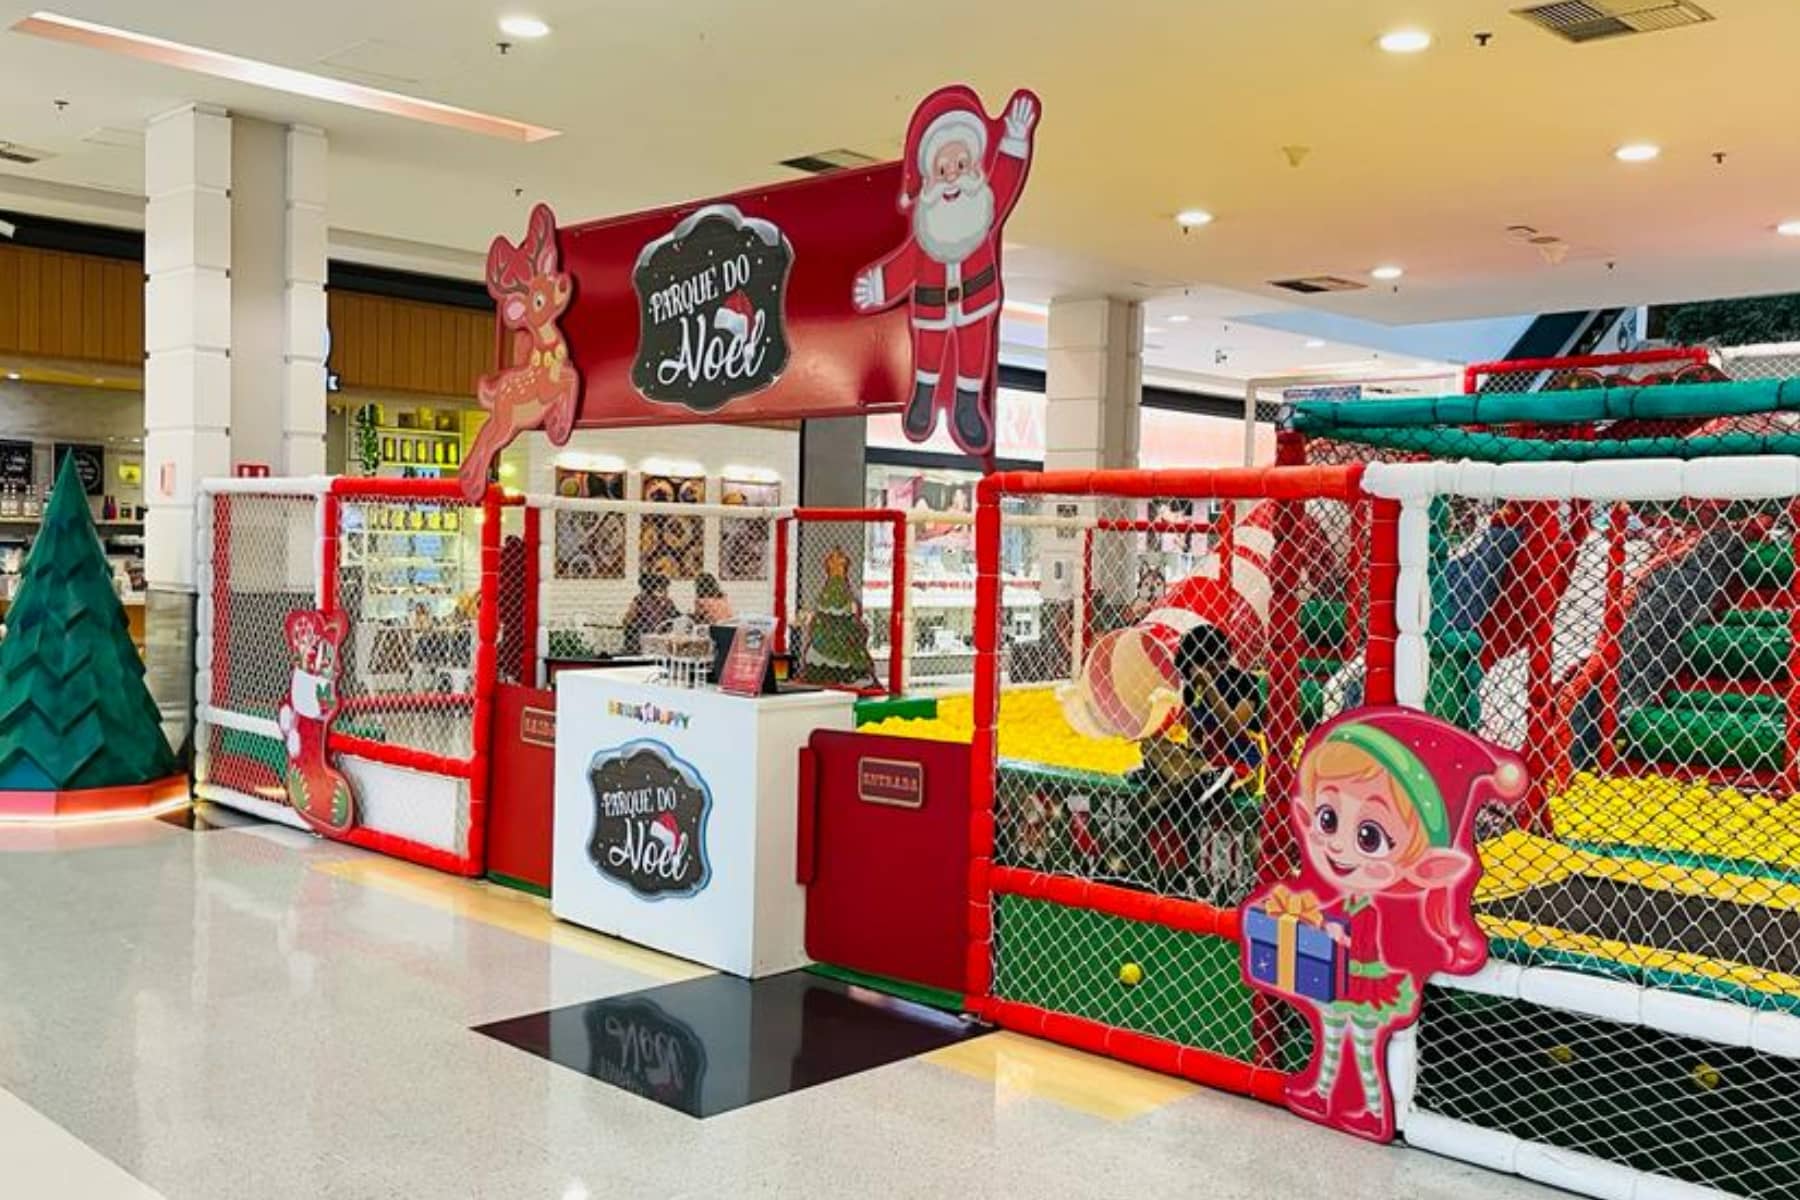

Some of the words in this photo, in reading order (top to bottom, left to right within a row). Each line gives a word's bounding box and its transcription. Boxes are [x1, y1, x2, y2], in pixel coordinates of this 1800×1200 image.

[649, 266, 719, 325] PARQUE
[722, 253, 750, 293] DO
[656, 308, 766, 386] Noel
[602, 787, 654, 819] PARQUE
[656, 786, 677, 811] DO
[608, 817, 690, 882] Noel
